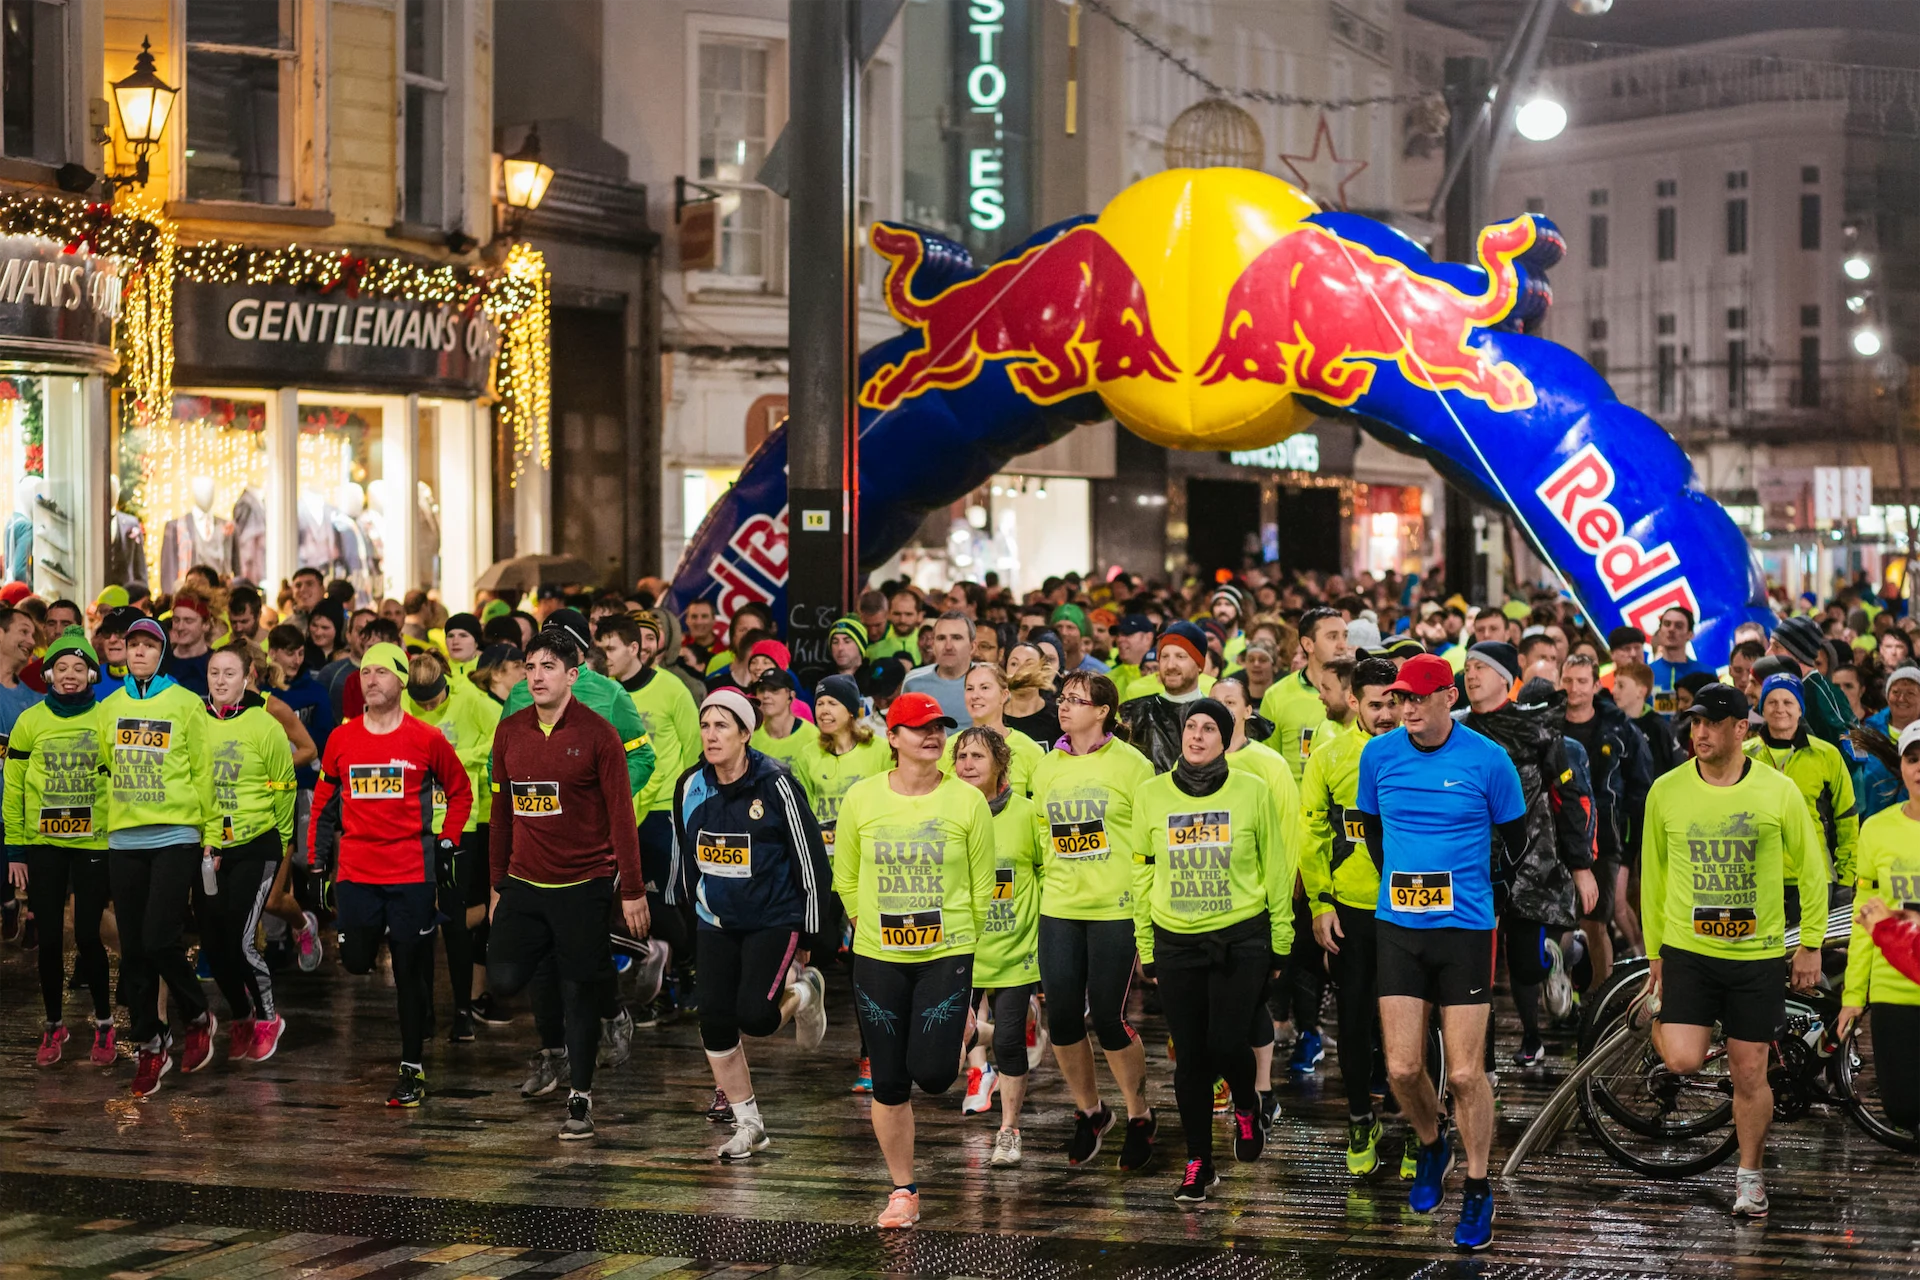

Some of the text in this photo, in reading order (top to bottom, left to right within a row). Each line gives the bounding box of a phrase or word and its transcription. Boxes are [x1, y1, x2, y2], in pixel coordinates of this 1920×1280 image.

[967, 0, 1007, 231] STOES
[227, 297, 459, 352] GENTLEMAN'S
[1541, 448, 1676, 597] Red
[122, 731, 164, 747] 9703
[44, 752, 98, 771] RUN
[119, 765, 154, 774] IN THE
[53, 771, 87, 779] IN THE
[113, 774, 166, 789] DARK
[44, 778, 97, 793] DARK
[352, 779, 402, 793] 11125
[136, 791, 166, 802] 2018
[517, 797, 553, 811] 9278
[1047, 799, 1108, 824] RUN
[41, 819, 91, 834] 10027
[1175, 825, 1220, 844] 9451
[1058, 834, 1101, 853] 9026
[1688, 840, 1758, 863] RUN
[703, 847, 743, 864] 9256
[874, 841, 946, 865] RUN
[1169, 847, 1233, 870] RUN
[888, 866, 932, 875] IN THE
[1180, 871, 1221, 879] IN THE
[1702, 863, 1746, 873] IN THE
[877, 876, 944, 893] DARK
[1170, 880, 1232, 898] DARK
[1692, 873, 1757, 891] DARK
[909, 896, 943, 908] 2018
[1200, 898, 1233, 912] 2018
[1397, 888, 1444, 906] 9734
[1724, 891, 1757, 904] 2018
[985, 919, 1017, 932] 2017
[1701, 921, 1750, 938] 9082
[883, 925, 941, 945] 10077
